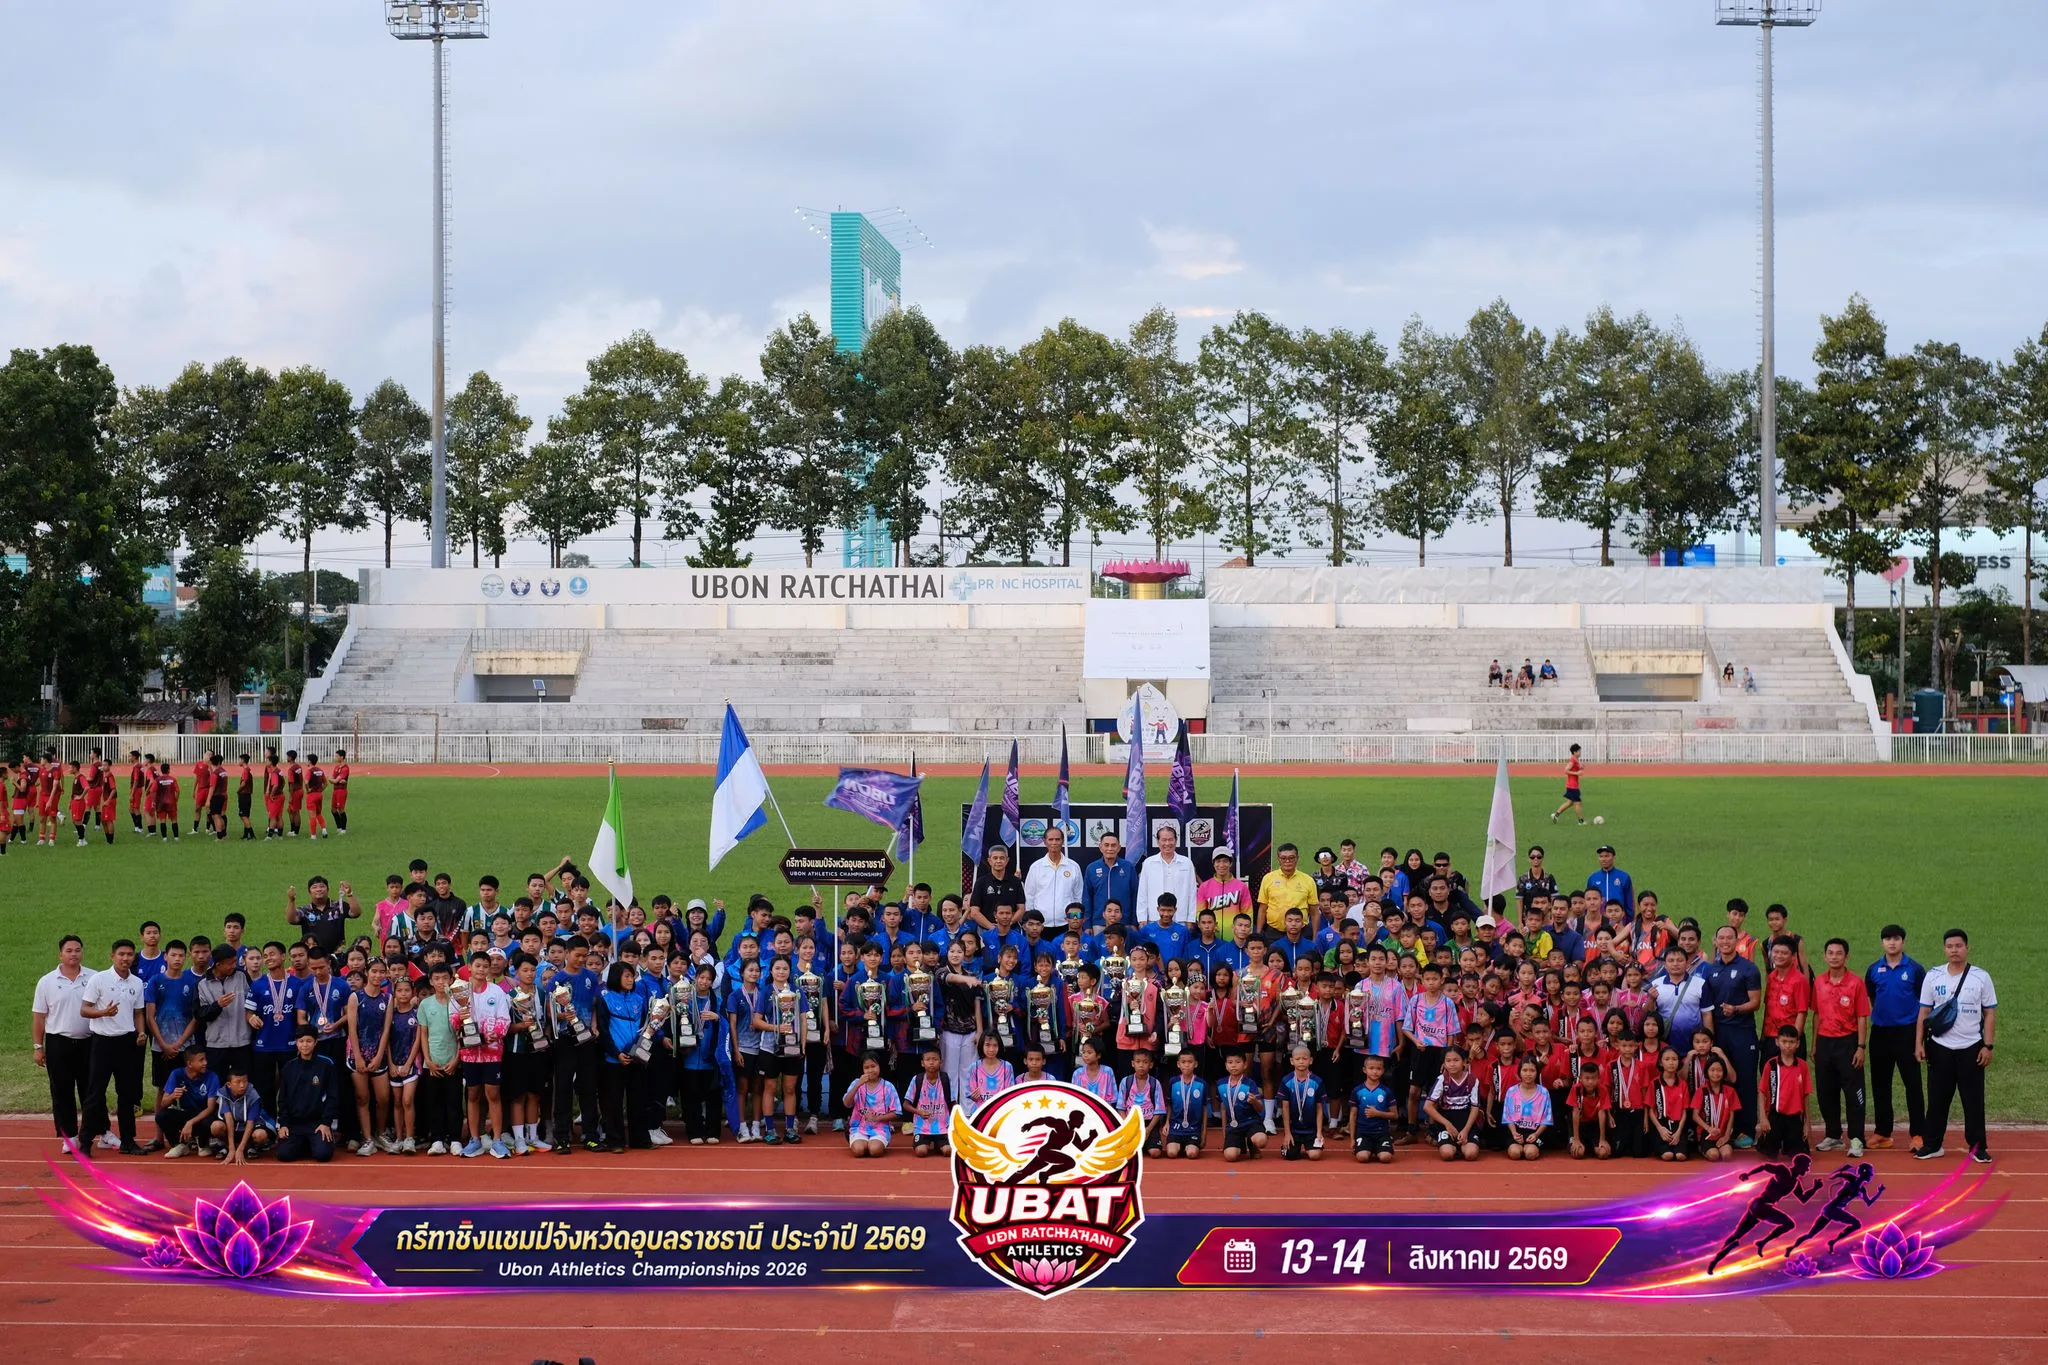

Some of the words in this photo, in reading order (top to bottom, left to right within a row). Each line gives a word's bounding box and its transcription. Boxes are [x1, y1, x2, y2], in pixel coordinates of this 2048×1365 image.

[691, 575, 769, 599] UBON
[977, 578, 1019, 590] PRNC
[1022, 578, 1083, 589] HOSPITAL
